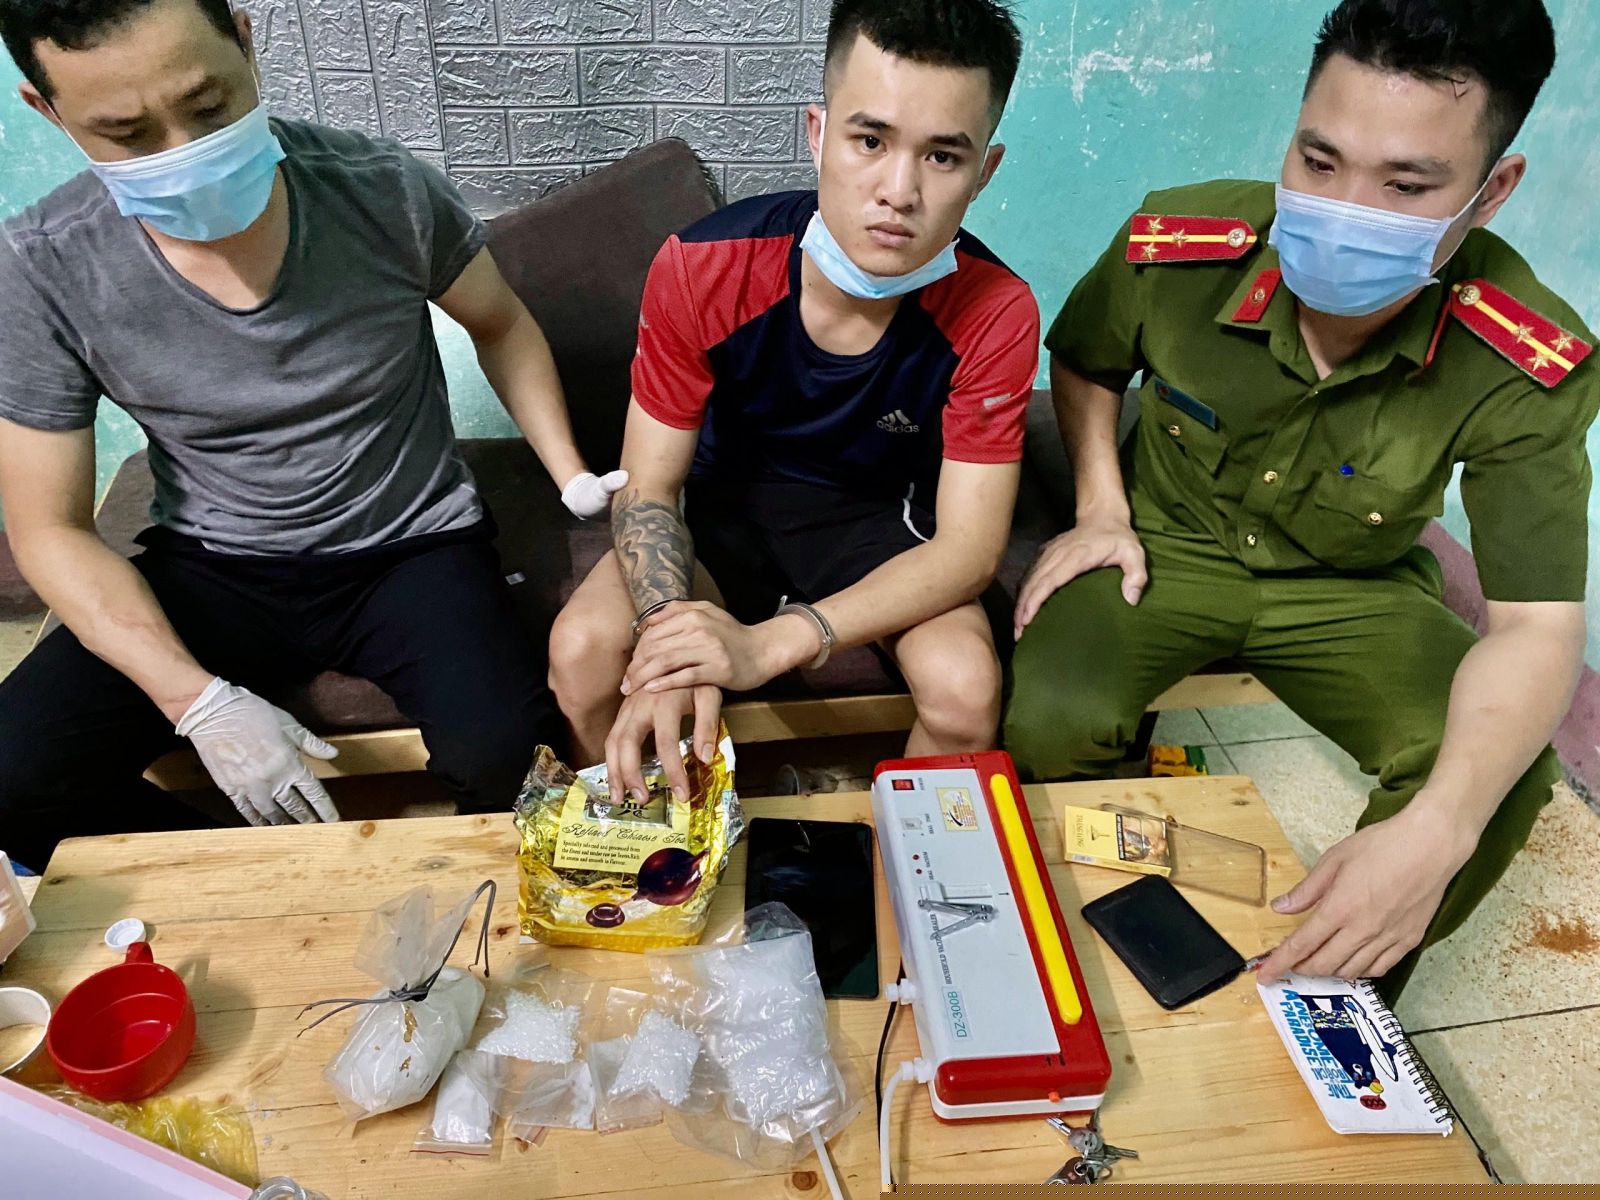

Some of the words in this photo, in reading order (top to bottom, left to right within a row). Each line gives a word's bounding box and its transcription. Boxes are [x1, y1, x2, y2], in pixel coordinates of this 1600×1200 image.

[876, 420, 920, 433] adidas
[562, 823, 615, 838] Refined
[616, 828, 658, 841] Chinese
[662, 832, 687, 844] Tea
[948, 991, 967, 1038] DZ-300B
[1280, 1002, 1323, 1068] PARADISE
